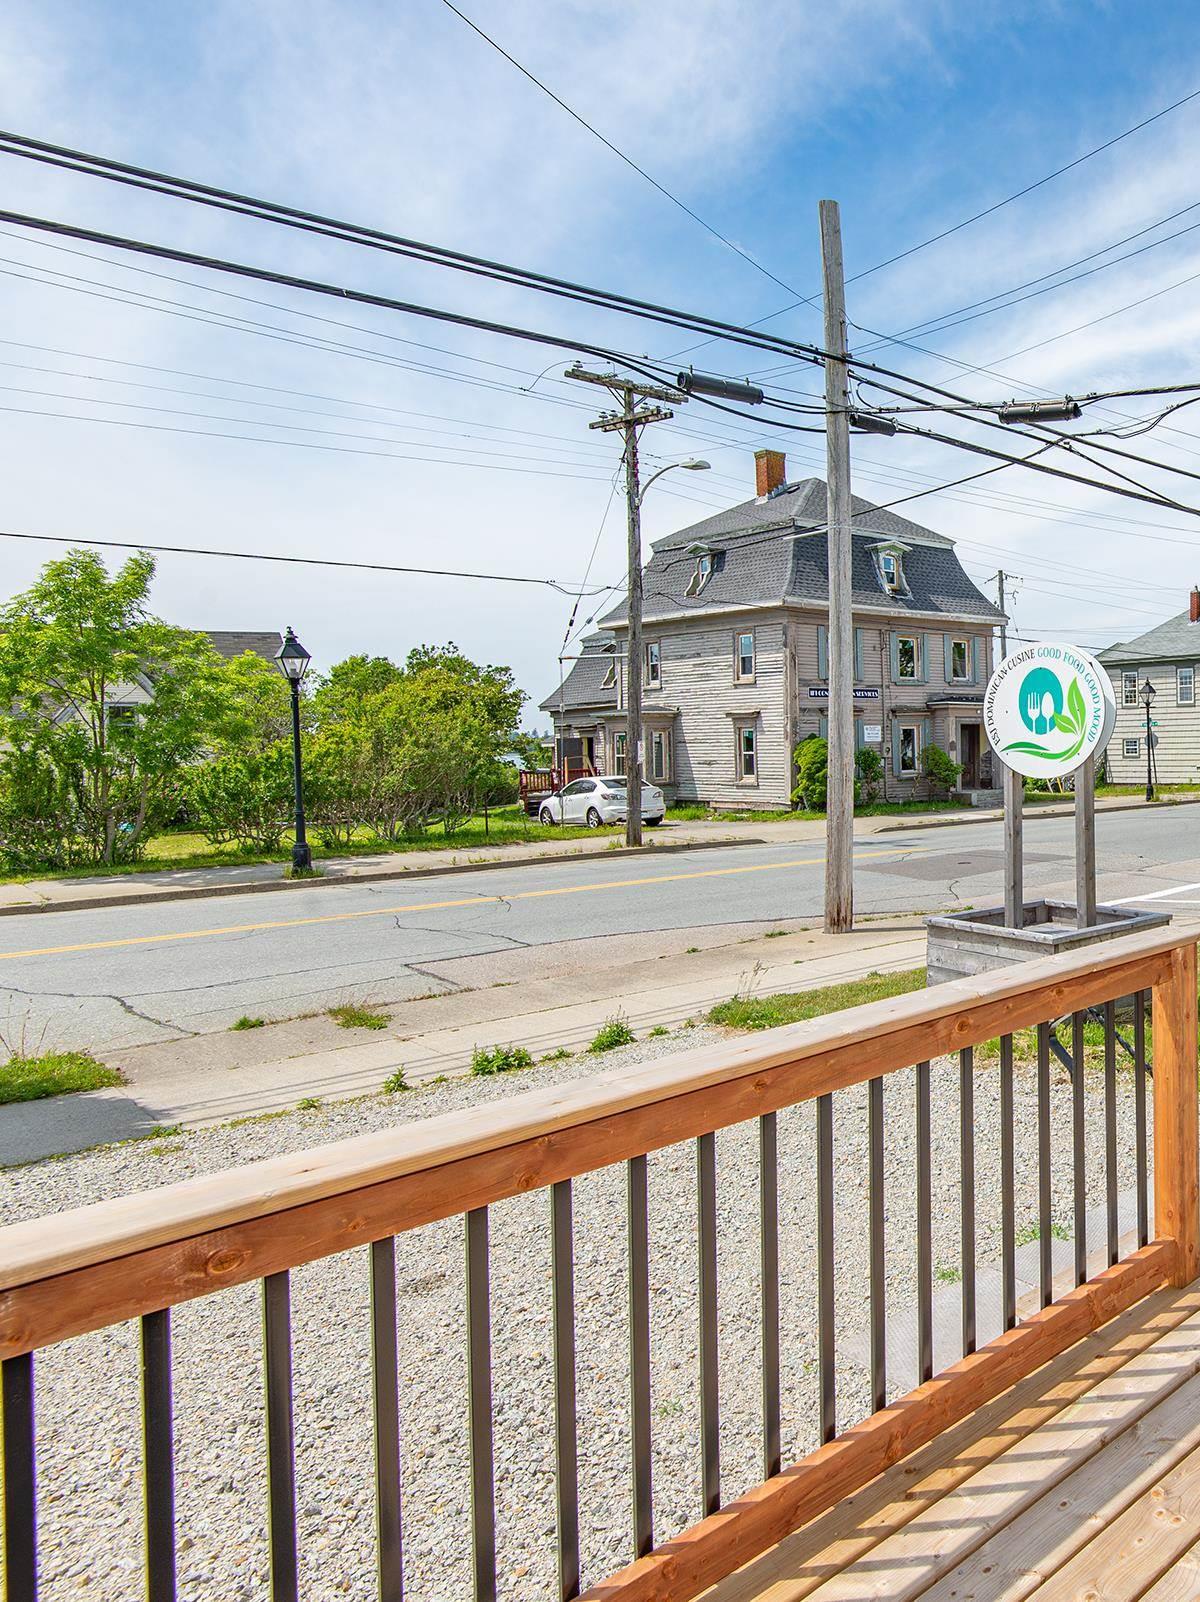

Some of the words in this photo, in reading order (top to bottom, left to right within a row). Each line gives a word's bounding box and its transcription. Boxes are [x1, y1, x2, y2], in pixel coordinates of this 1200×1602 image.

[1037, 647, 1062, 660] GOOD
[1063, 652, 1086, 675] FOOD
[987, 668, 1008, 727] DOMINICAN
[1007, 648, 1036, 671] CUSINE
[1084, 672, 1101, 705] GOOD
[1087, 706, 1102, 743] MOOD
